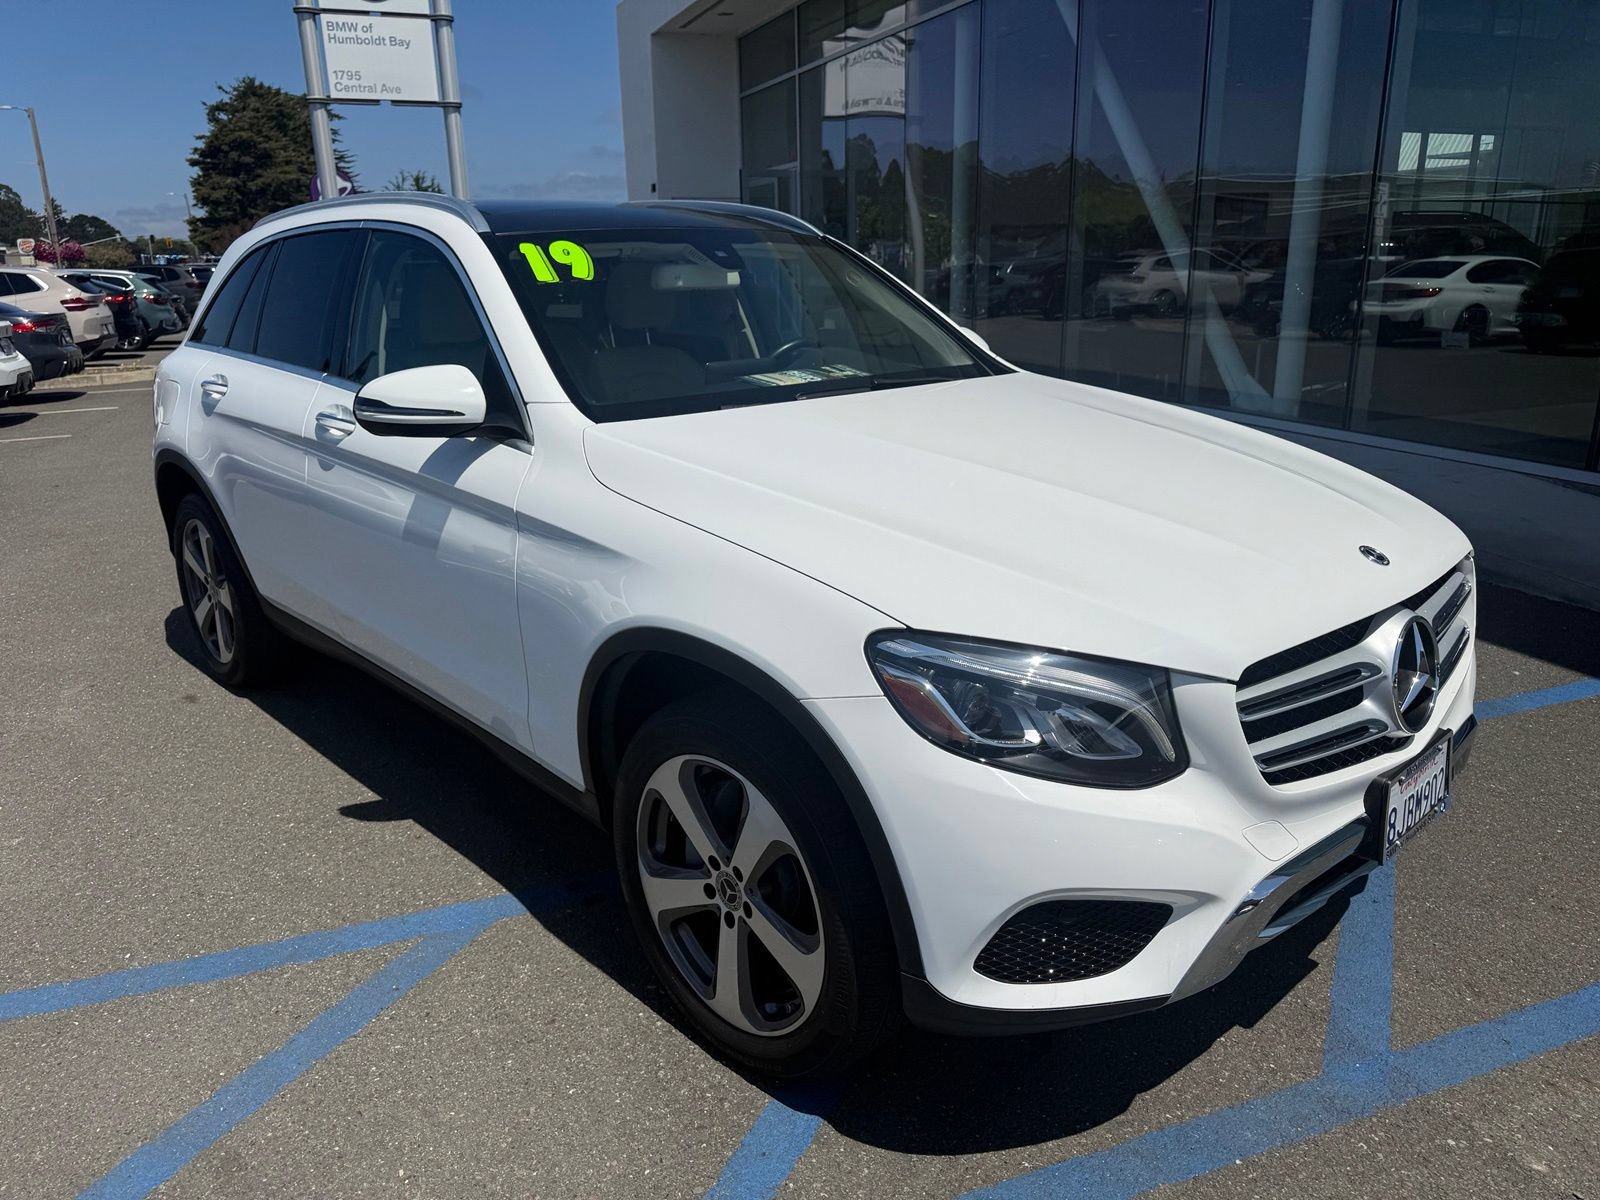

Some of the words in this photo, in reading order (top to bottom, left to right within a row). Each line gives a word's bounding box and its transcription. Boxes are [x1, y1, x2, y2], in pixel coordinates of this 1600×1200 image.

[326, 21, 358, 32] BMW
[361, 23, 373, 33] of
[328, 34, 386, 46] Humboldt
[389, 36, 411, 49] Bay
[332, 70, 361, 81] 1795
[334, 82, 377, 94] Central
[380, 83, 402, 95] Ave
[519, 240, 594, 282] 19
[1387, 767, 1445, 846] 8JBM902
